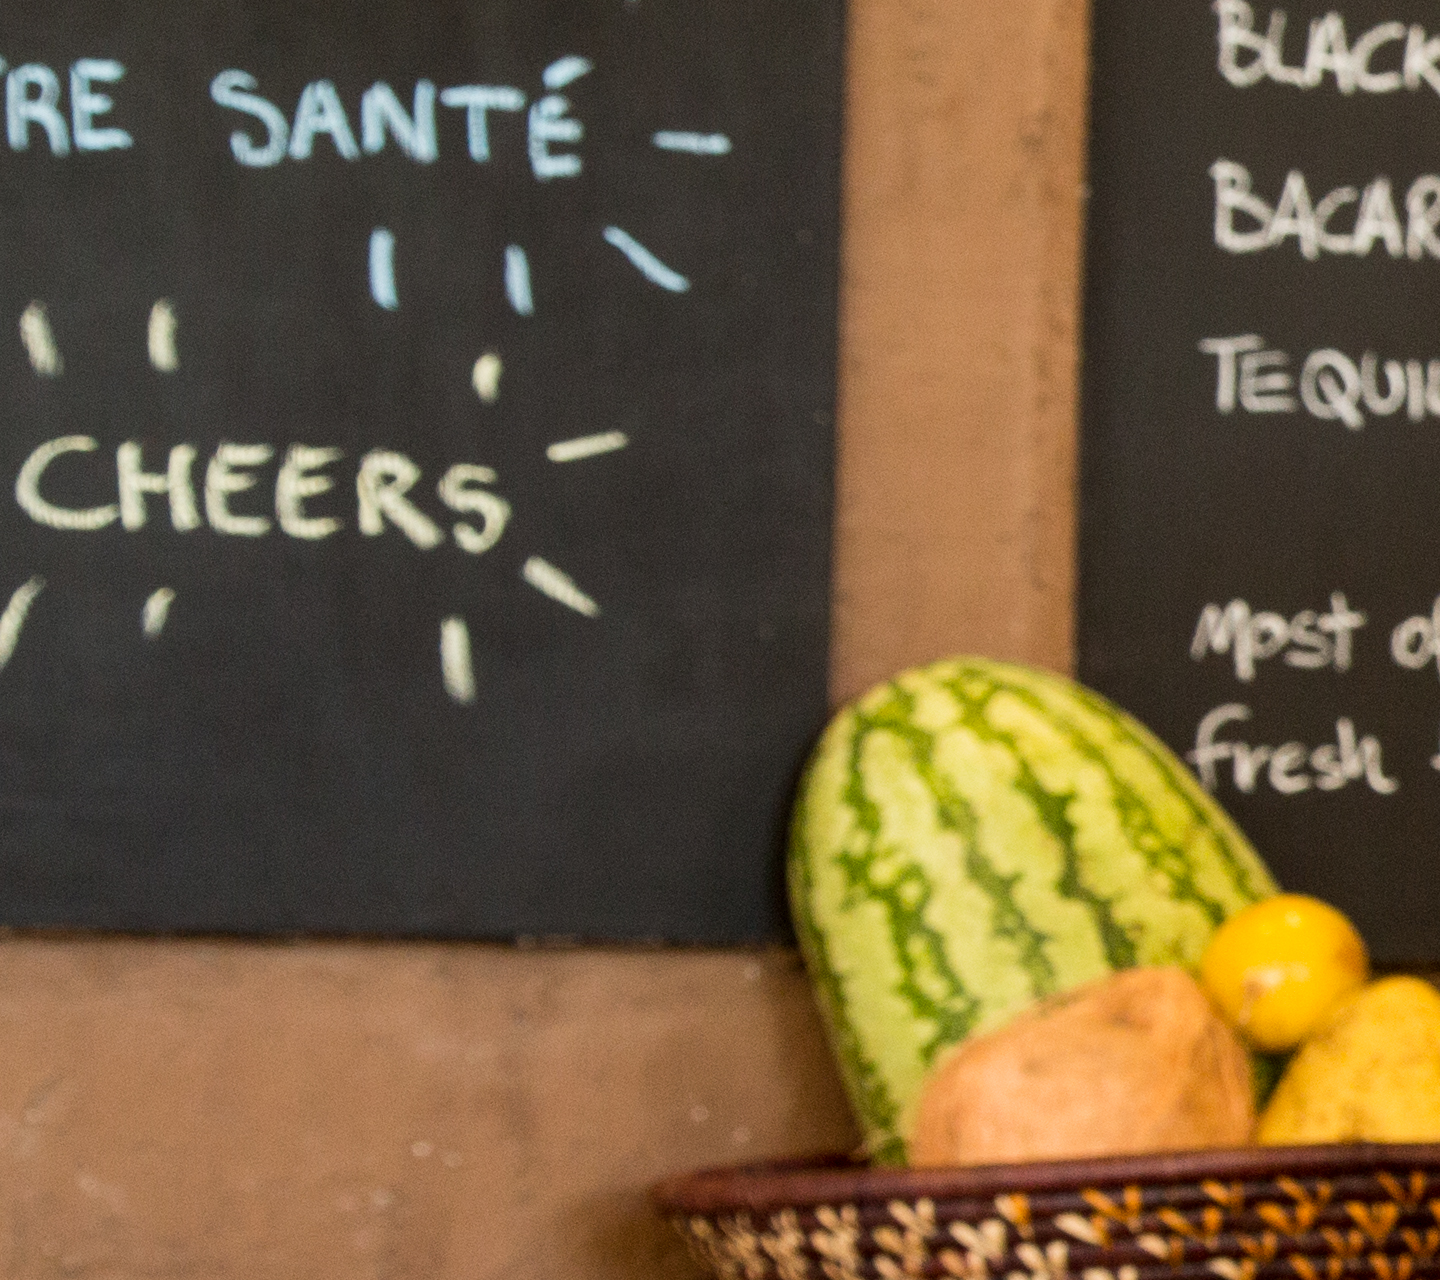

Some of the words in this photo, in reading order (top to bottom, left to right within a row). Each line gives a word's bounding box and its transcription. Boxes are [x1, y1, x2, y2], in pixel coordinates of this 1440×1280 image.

[0, 55, 134, 157] RE
[208, 54, 590, 181] SANTÉ
[13, 433, 512, 556] CHEERS
[1189, 702, 1398, 795] fresh
